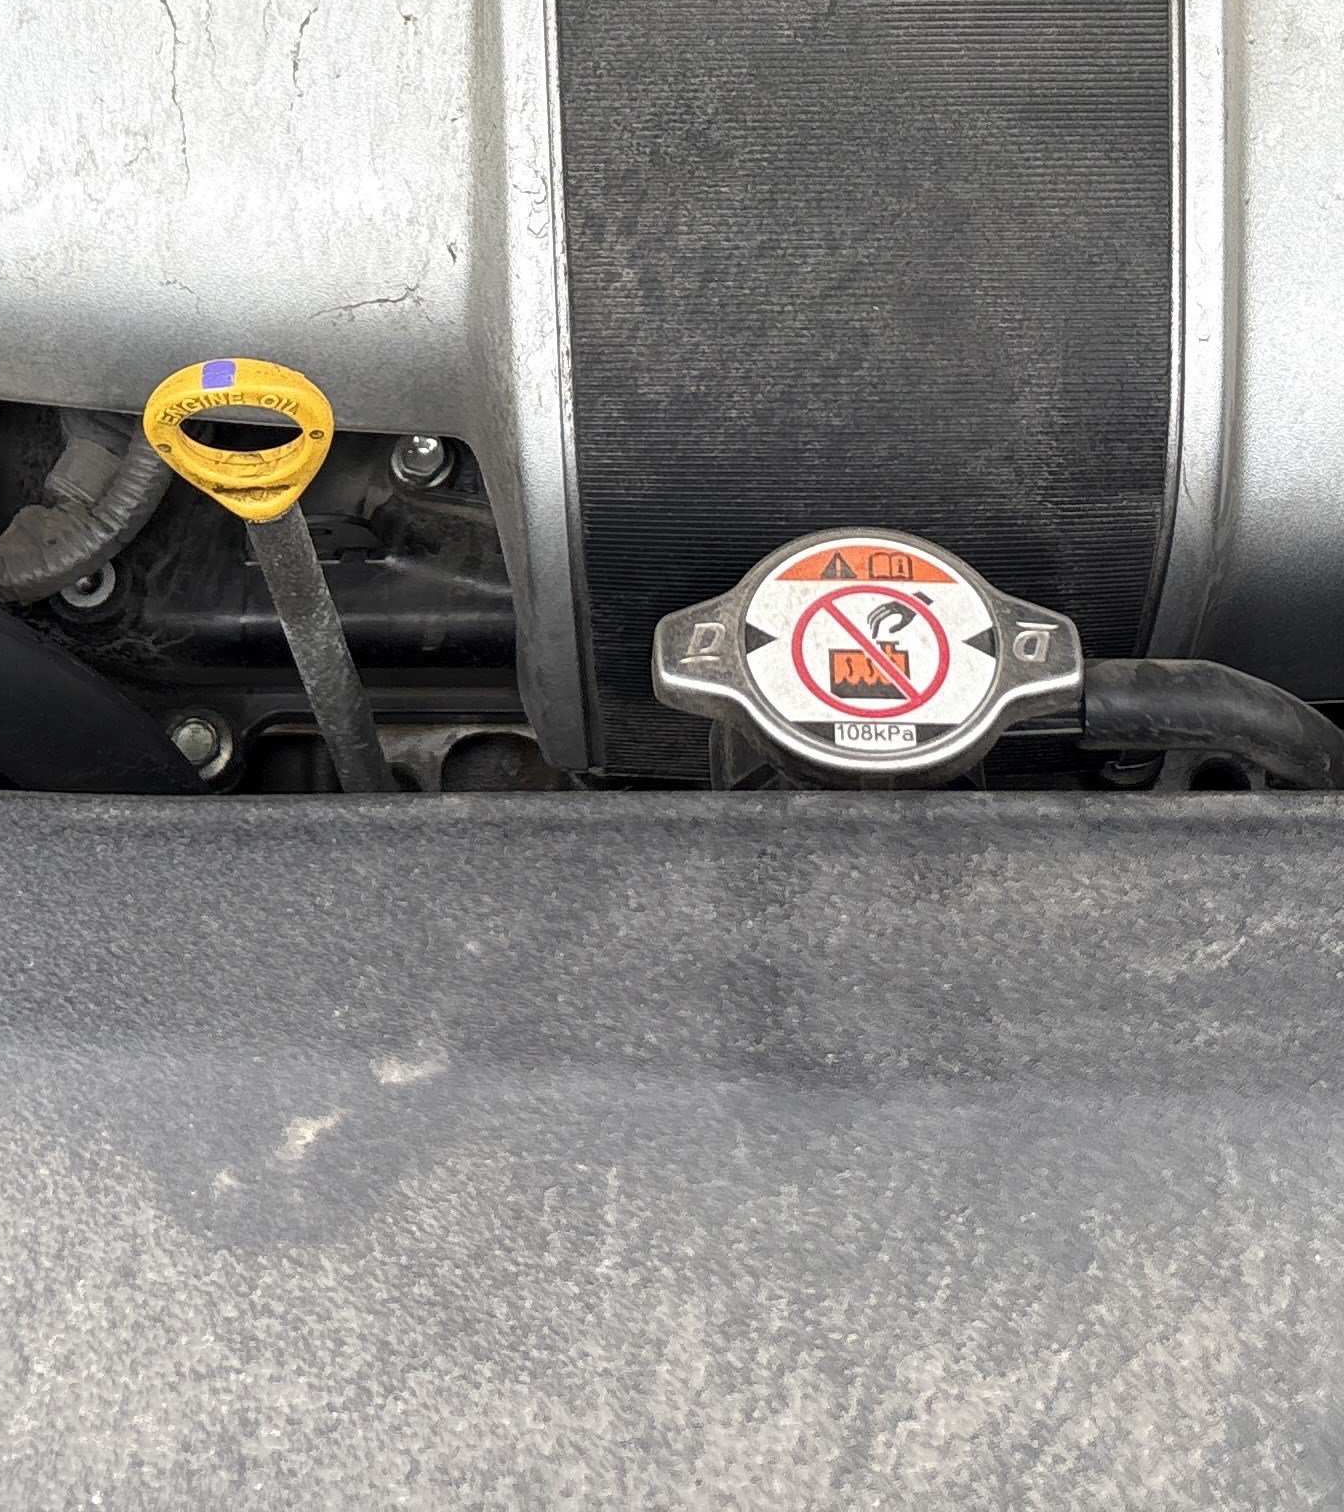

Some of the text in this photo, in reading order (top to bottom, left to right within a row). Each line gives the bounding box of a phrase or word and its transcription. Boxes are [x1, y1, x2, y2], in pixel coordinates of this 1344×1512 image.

[156, 390, 300, 427] ENGINE OIL
[836, 723, 915, 742] 108kPa
